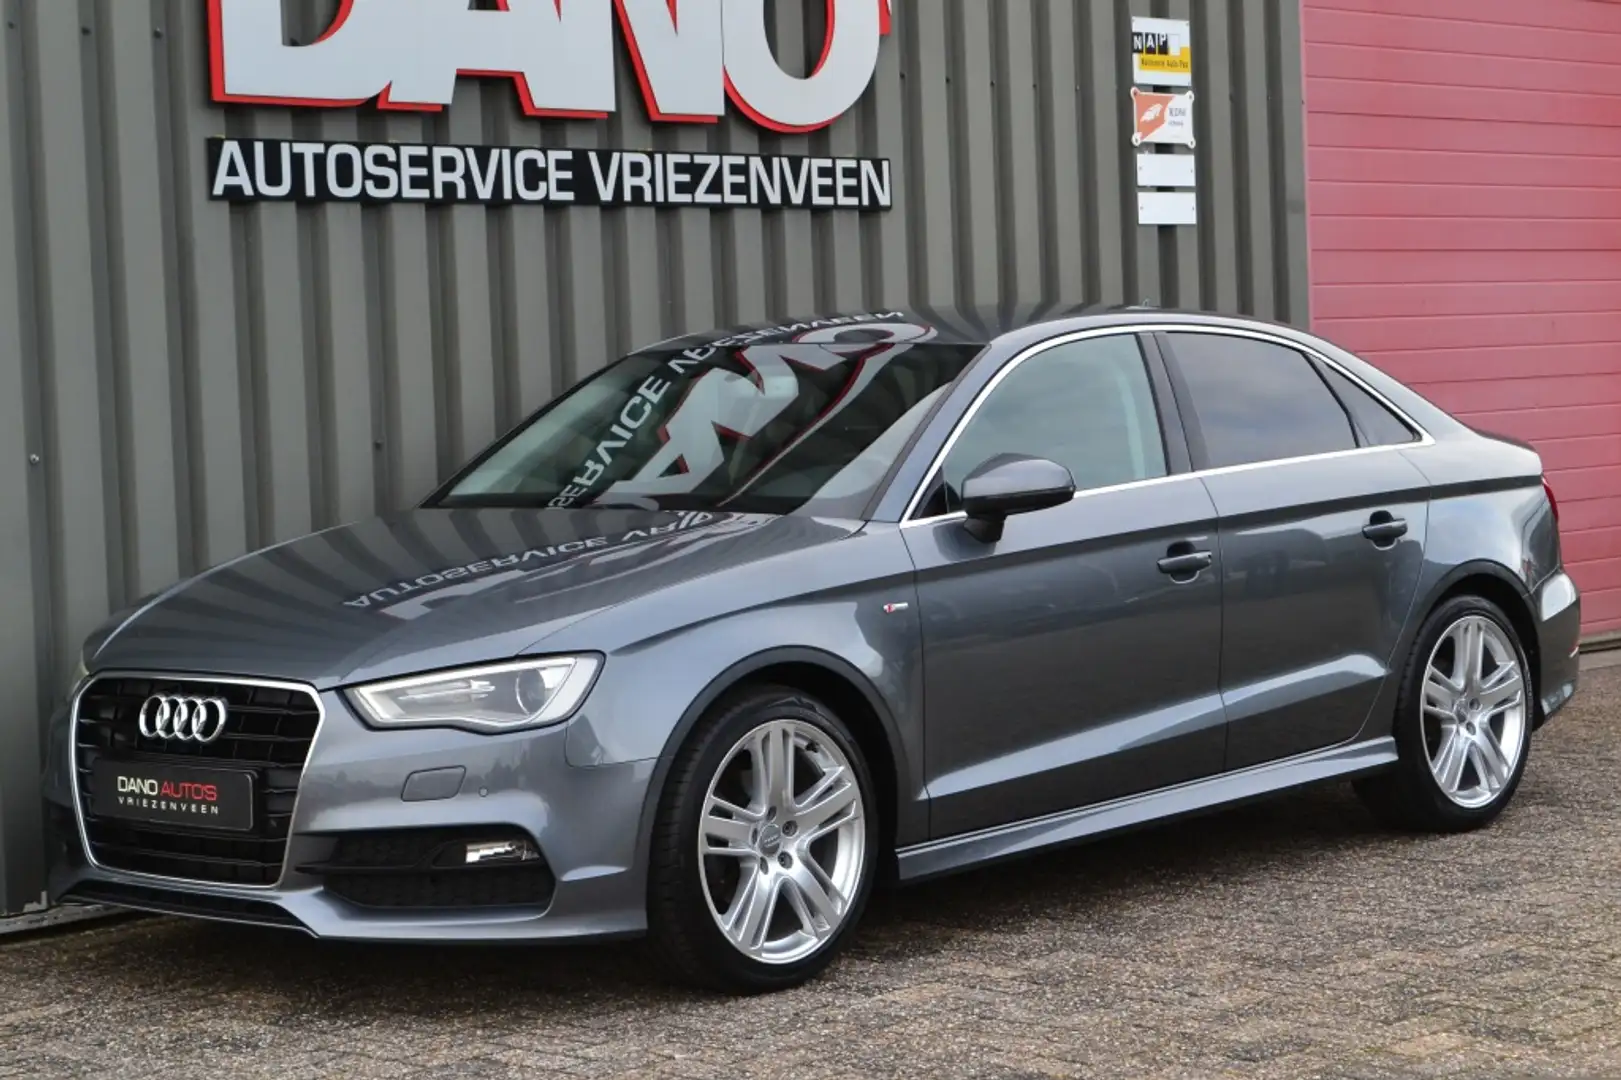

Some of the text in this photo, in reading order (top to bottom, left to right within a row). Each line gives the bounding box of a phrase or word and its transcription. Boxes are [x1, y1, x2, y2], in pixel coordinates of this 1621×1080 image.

[1133, 33, 1167, 50] NAP
[212, 139, 891, 207] AUTOSERVICE VRIEZENVEEN
[117, 775, 217, 801] DANO AUTOS
[118, 796, 219, 814] VRIEZENVEEN
